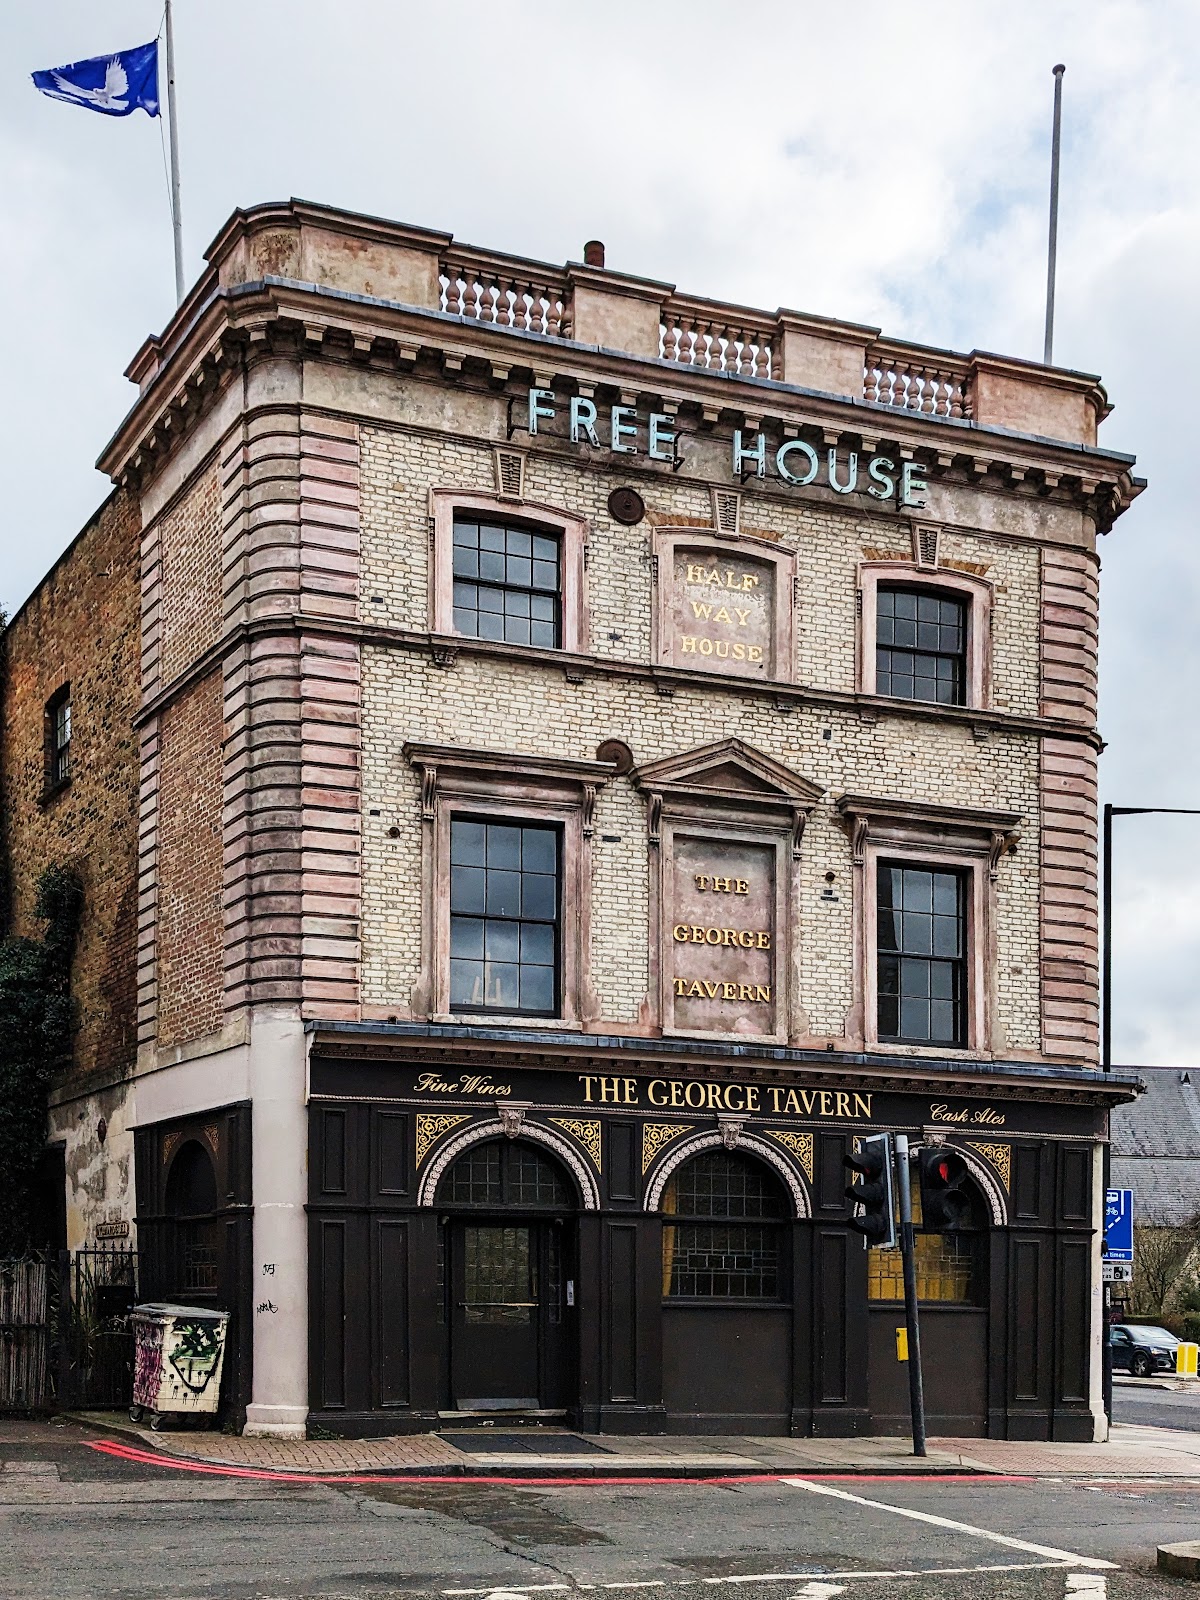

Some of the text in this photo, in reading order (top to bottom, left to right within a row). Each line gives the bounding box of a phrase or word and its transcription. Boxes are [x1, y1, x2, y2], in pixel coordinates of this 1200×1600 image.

[528, 388, 928, 509] FREE HOUSE
[686, 565, 759, 592] HALF
[690, 601, 751, 626] WAY
[681, 636, 763, 663] HOUSE
[695, 874, 749, 895] THE
[673, 924, 771, 950] GEORGE
[673, 977, 771, 1003] TAVERN
[413, 1072, 512, 1096] Fine Wines
[578, 1075, 873, 1119] THE GEORGE TAVERN
[930, 1103, 1006, 1125] Cask Ales
